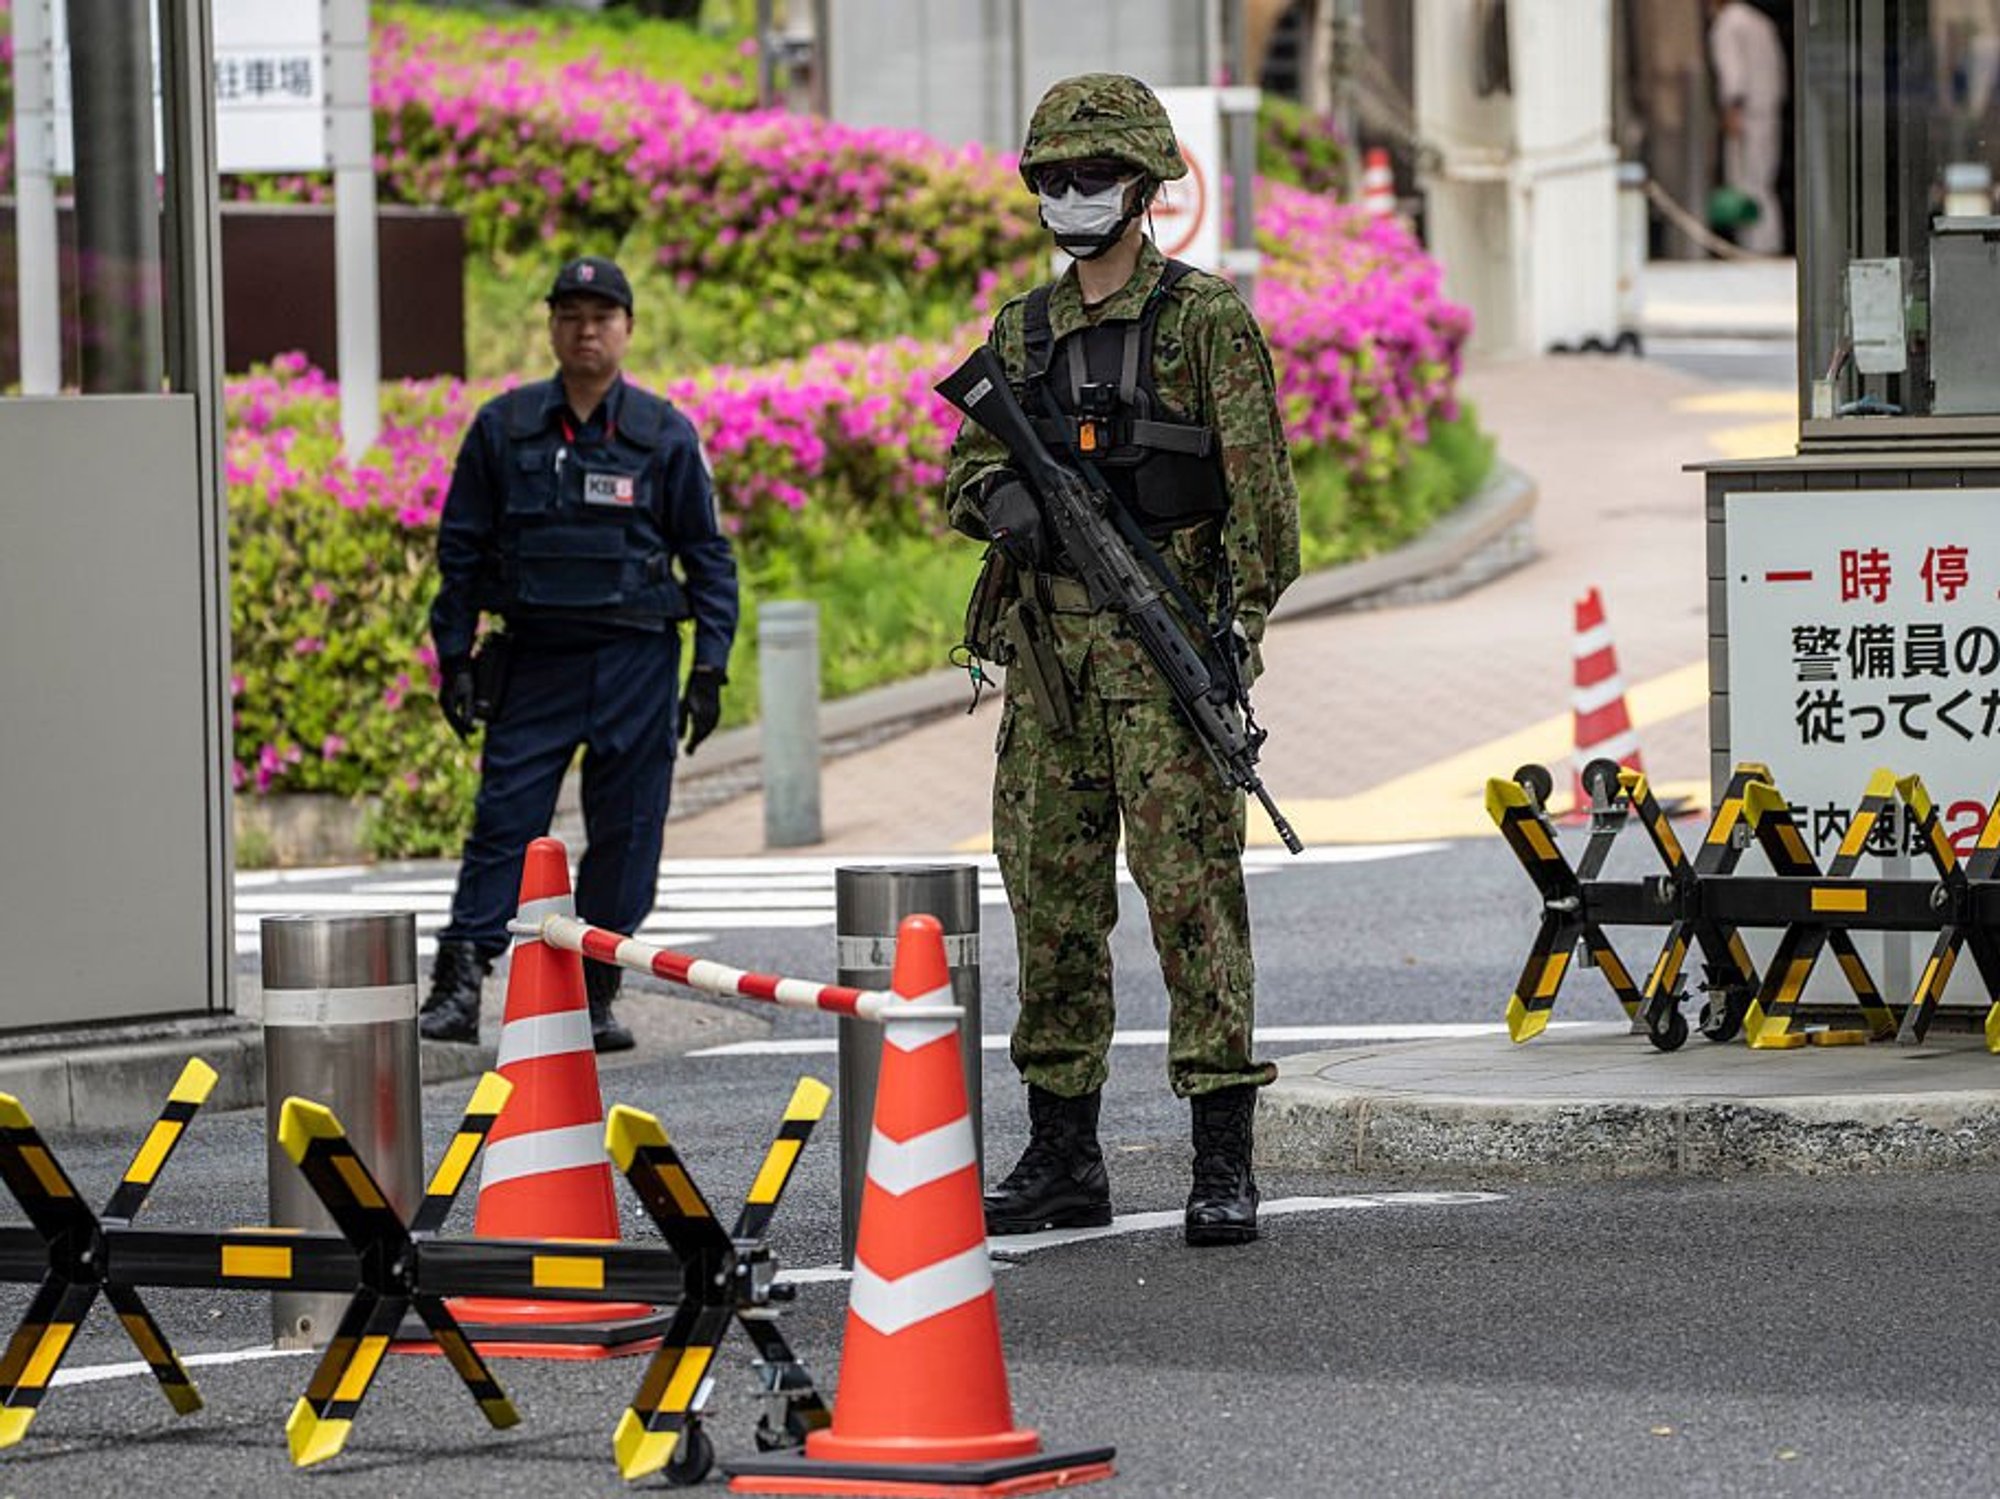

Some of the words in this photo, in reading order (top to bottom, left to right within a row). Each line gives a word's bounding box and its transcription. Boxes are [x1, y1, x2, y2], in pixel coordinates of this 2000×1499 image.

[213, 58, 312, 99] 駐車場
[1766, 545, 2000, 603] 一時停
[1791, 623, 2000, 682] 警備員の
